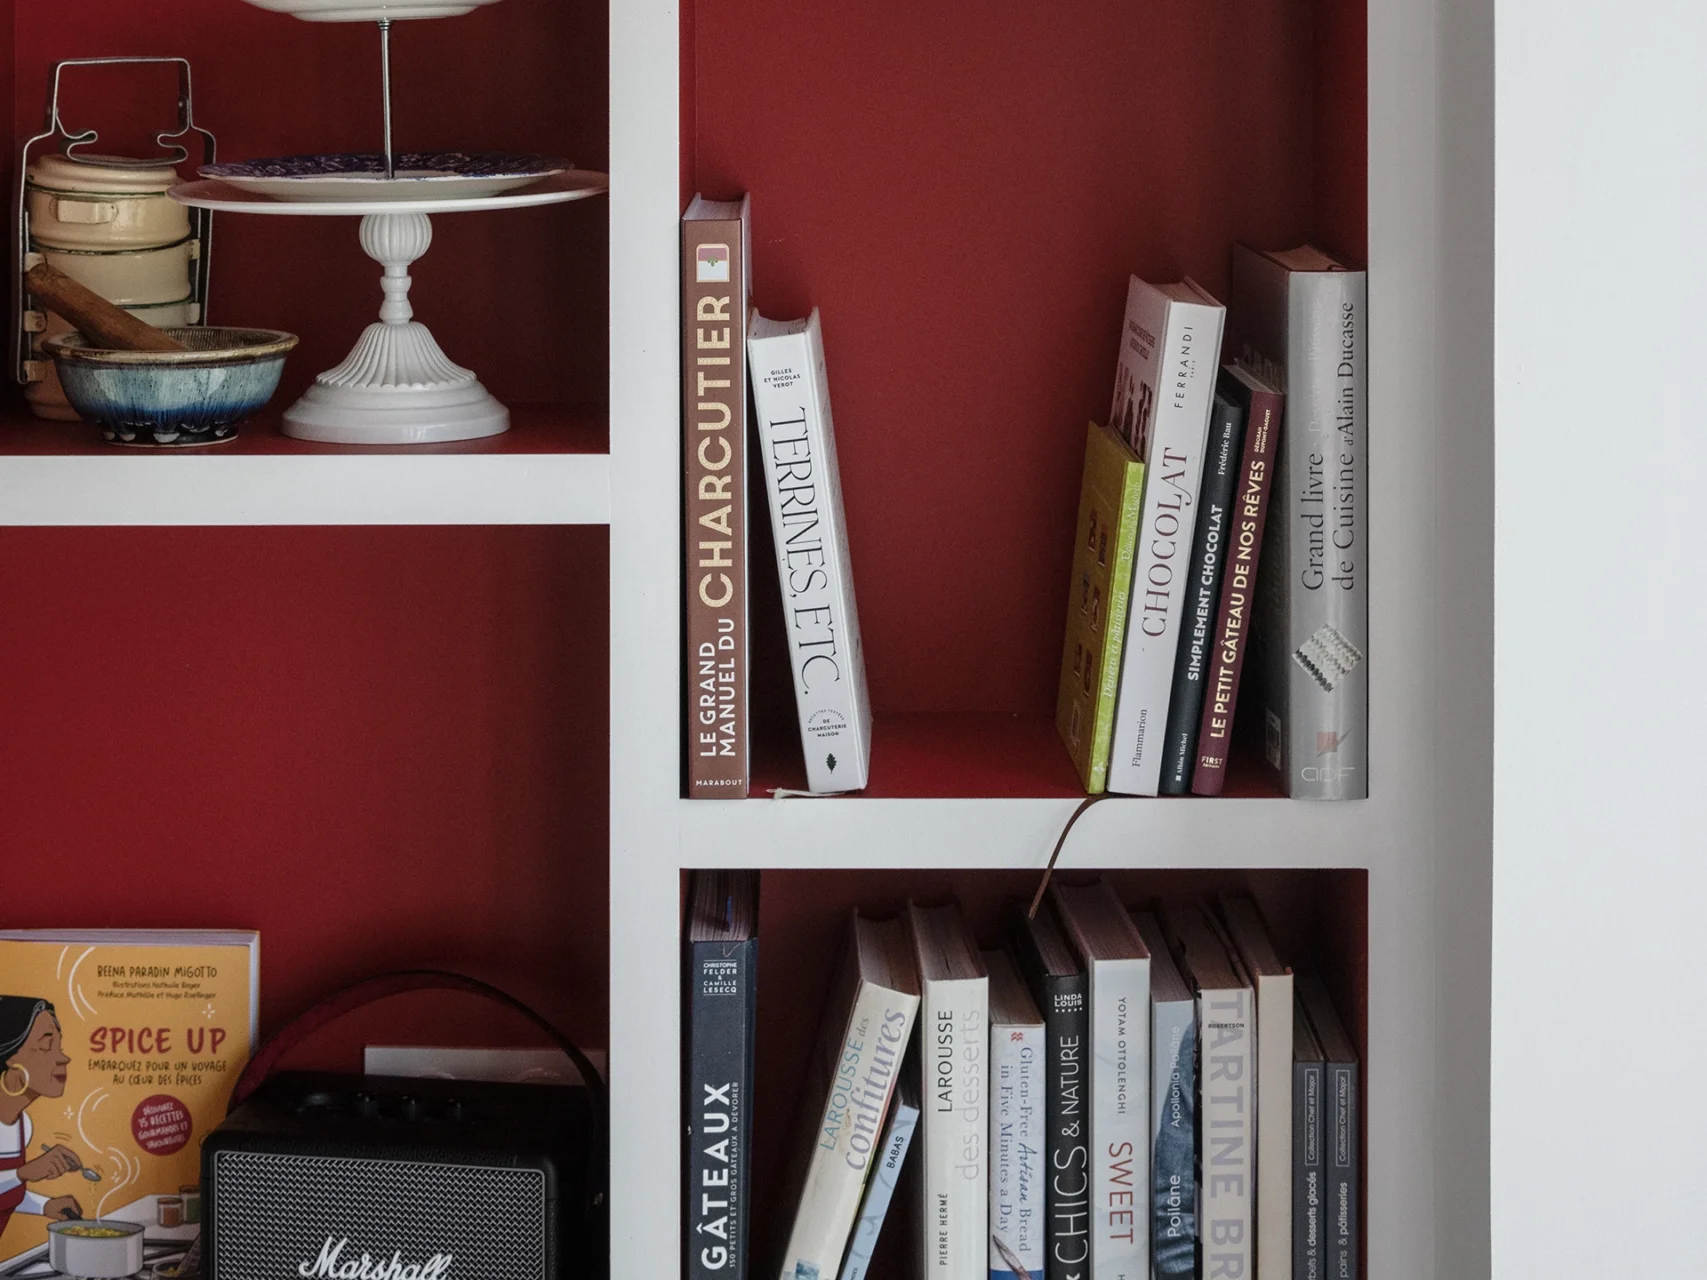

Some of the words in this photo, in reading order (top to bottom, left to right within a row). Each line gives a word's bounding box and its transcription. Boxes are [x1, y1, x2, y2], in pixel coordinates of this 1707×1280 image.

[1337, 302, 1354, 379] Ducasse
[773, 373, 801, 382] NICOLAS
[1174, 325, 1194, 409] FERRANDI
[1223, 422, 1232, 439] Bau
[696, 295, 734, 608] CHARCUTIER
[1217, 440, 1230, 476] Frédéric
[1242, 460, 1266, 517] RÊVES
[1301, 452, 1324, 505] livre
[769, 405, 828, 598] TERRINES,
[1332, 452, 1354, 550] Cuisine
[1142, 446, 1193, 638] CHOCOLAT
[1237, 520, 1256, 560] NOS
[1302, 513, 1324, 591] Grand
[1187, 590, 1212, 681] SIMPLEMENT
[1201, 504, 1223, 586] CHOCOLAT
[1232, 564, 1250, 589] DE
[1332, 560, 1354, 591] de
[717, 618, 735, 650] DU
[1102, 656, 1118, 698] Desserts
[1111, 590, 1126, 642] pâtisseries
[1220, 592, 1245, 663] GÂTEAU
[793, 604, 840, 695] ETC.
[699, 641, 716, 726] GRAND
[1214, 667, 1234, 714] PETIT
[718, 657, 736, 757] MANUEL
[700, 730, 717, 757] LE
[808, 723, 847, 732] CHARCUTERIE
[1131, 709, 1148, 767] Flammarion
[1180, 733, 1188, 757] Michel
[1210, 717, 1226, 738] LE
[1177, 757, 1185, 776] Albin
[1202, 756, 1223, 765] FIRST
[97, 965, 126, 978] BEENA
[1054, 993, 1082, 1001] LINDA
[1054, 999, 1082, 1007] LOUIS
[1117, 997, 1127, 1035] YOTAM
[89, 1026, 172, 1054] SPICE
[187, 1026, 227, 1055] UP
[1170, 1025, 1180, 1069] Poilâne
[88, 1059, 142, 1072] EMBARQUEZ
[145, 1060, 170, 1071] POUR
[174, 1060, 188, 1071] UN
[191, 1060, 227, 1072] VOYAGE
[112, 1074, 125, 1085] AU
[157, 1074, 172, 1085] DES
[175, 1072, 202, 1086] ÉPICES
[937, 1010, 954, 1112] LAROUSSE
[955, 1008, 979, 1120] desserts
[1001, 1065, 1009, 1076] in
[1060, 1035, 1079, 1114] NATURE
[1117, 1041, 1127, 1114] OTTOLENGHI
[819, 1037, 864, 1151] LAROUSSE
[859, 1016, 869, 1038] des
[845, 1008, 906, 1171] confitures
[1001, 1084, 1013, 1117] Five
[1019, 1046, 1033, 1138] Gluten-Free
[1170, 1070, 1180, 1127] Apollonia
[1210, 991, 1244, 1198] TARTINE
[1308, 1075, 1316, 1096] Major
[1338, 1076, 1347, 1096] Major
[1338, 1097, 1346, 1105] et
[149, 1110, 184, 1126] RECETTES
[1061, 1120, 1080, 1137] &
[1338, 1107, 1346, 1124] Chef
[886, 1135, 904, 1169] BABAS
[955, 1135, 979, 1180] des
[1001, 1123, 1013, 1183] Minutes
[1338, 1125, 1346, 1162] Collection
[696, 1082, 730, 1270] GÂTEAUX
[730, 1179, 738, 1202] GROS
[1001, 1188, 1008, 1196] a
[1018, 1142, 1038, 1204] Artisan
[1307, 1171, 1319, 1206] glacés
[730, 1206, 737, 1217] ET
[937, 1193, 948, 1226] HERMÉ
[1054, 1145, 1088, 1263] CHICS
[1108, 1142, 1134, 1243] SWEET
[1167, 1174, 1181, 1237] Poilâne
[1337, 1182, 1349, 1235] pâtisseries
[729, 1220, 737, 1250] PETITS
[1000, 1203, 1013, 1234] Day
[1018, 1208, 1032, 1252] Bread
[1307, 1207, 1317, 1247] desserts
[298, 1236, 453, 1280] Marshall
[939, 1229, 948, 1266] PIERRE
[1307, 1248, 1317, 1257] &
[1338, 1236, 1348, 1245] &
[1340, 1250, 1349, 1278] pains
